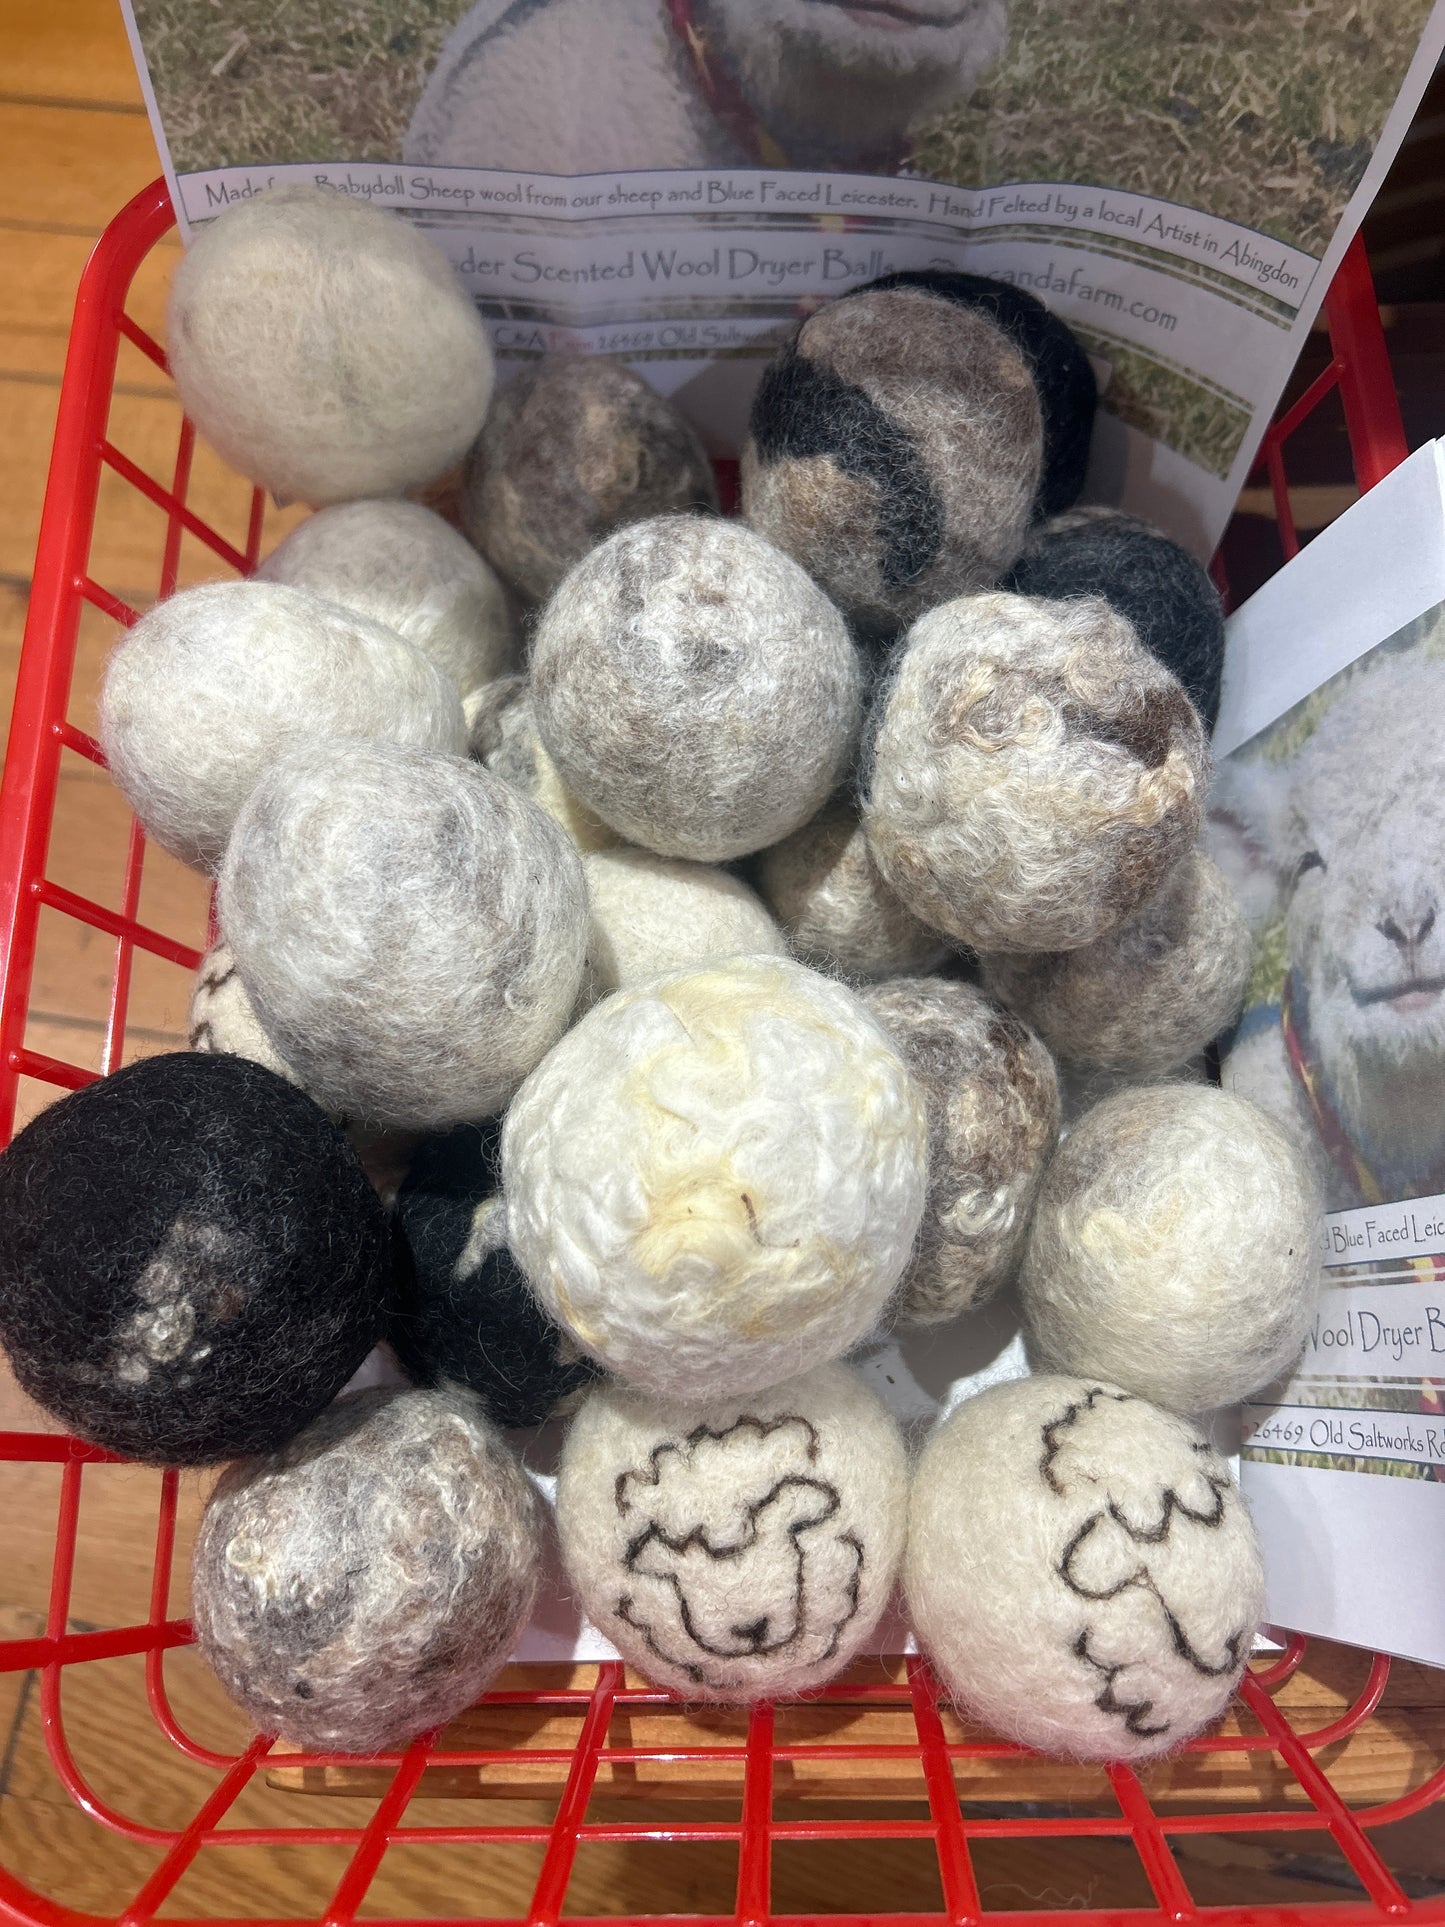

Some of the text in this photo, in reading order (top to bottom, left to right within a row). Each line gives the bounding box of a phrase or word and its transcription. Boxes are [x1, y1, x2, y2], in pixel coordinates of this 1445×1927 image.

[409, 177, 474, 207] Sheep
[480, 182, 522, 203] wool
[526, 184, 567, 207] from
[572, 192, 602, 209] our
[607, 184, 662, 210] sheep
[668, 181, 702, 202] and
[707, 180, 754, 203] Blue
[760, 180, 821, 202] Faced
[928, 193, 983, 218] Hand
[987, 194, 1051, 218] Felted
[1055, 198, 1078, 222] by
[1082, 206, 1094, 219] a
[1099, 201, 1143, 228] local
[1143, 213, 1202, 247] Artist
[1203, 233, 1219, 255] in
[1220, 240, 1299, 290] Abingdon
[511, 251, 634, 284] Scented
[641, 249, 720, 282] Wool
[728, 248, 815, 286] Dryer
[1332, 1225, 1364, 1253] Blue
[1366, 1215, 1409, 1248] Faced
[1358, 1311, 1422, 1361] Dryer
[1252, 1420, 1303, 1444] 26469
[1310, 1419, 1343, 1447] Old
[1348, 1422, 1424, 1452] Saltworks
